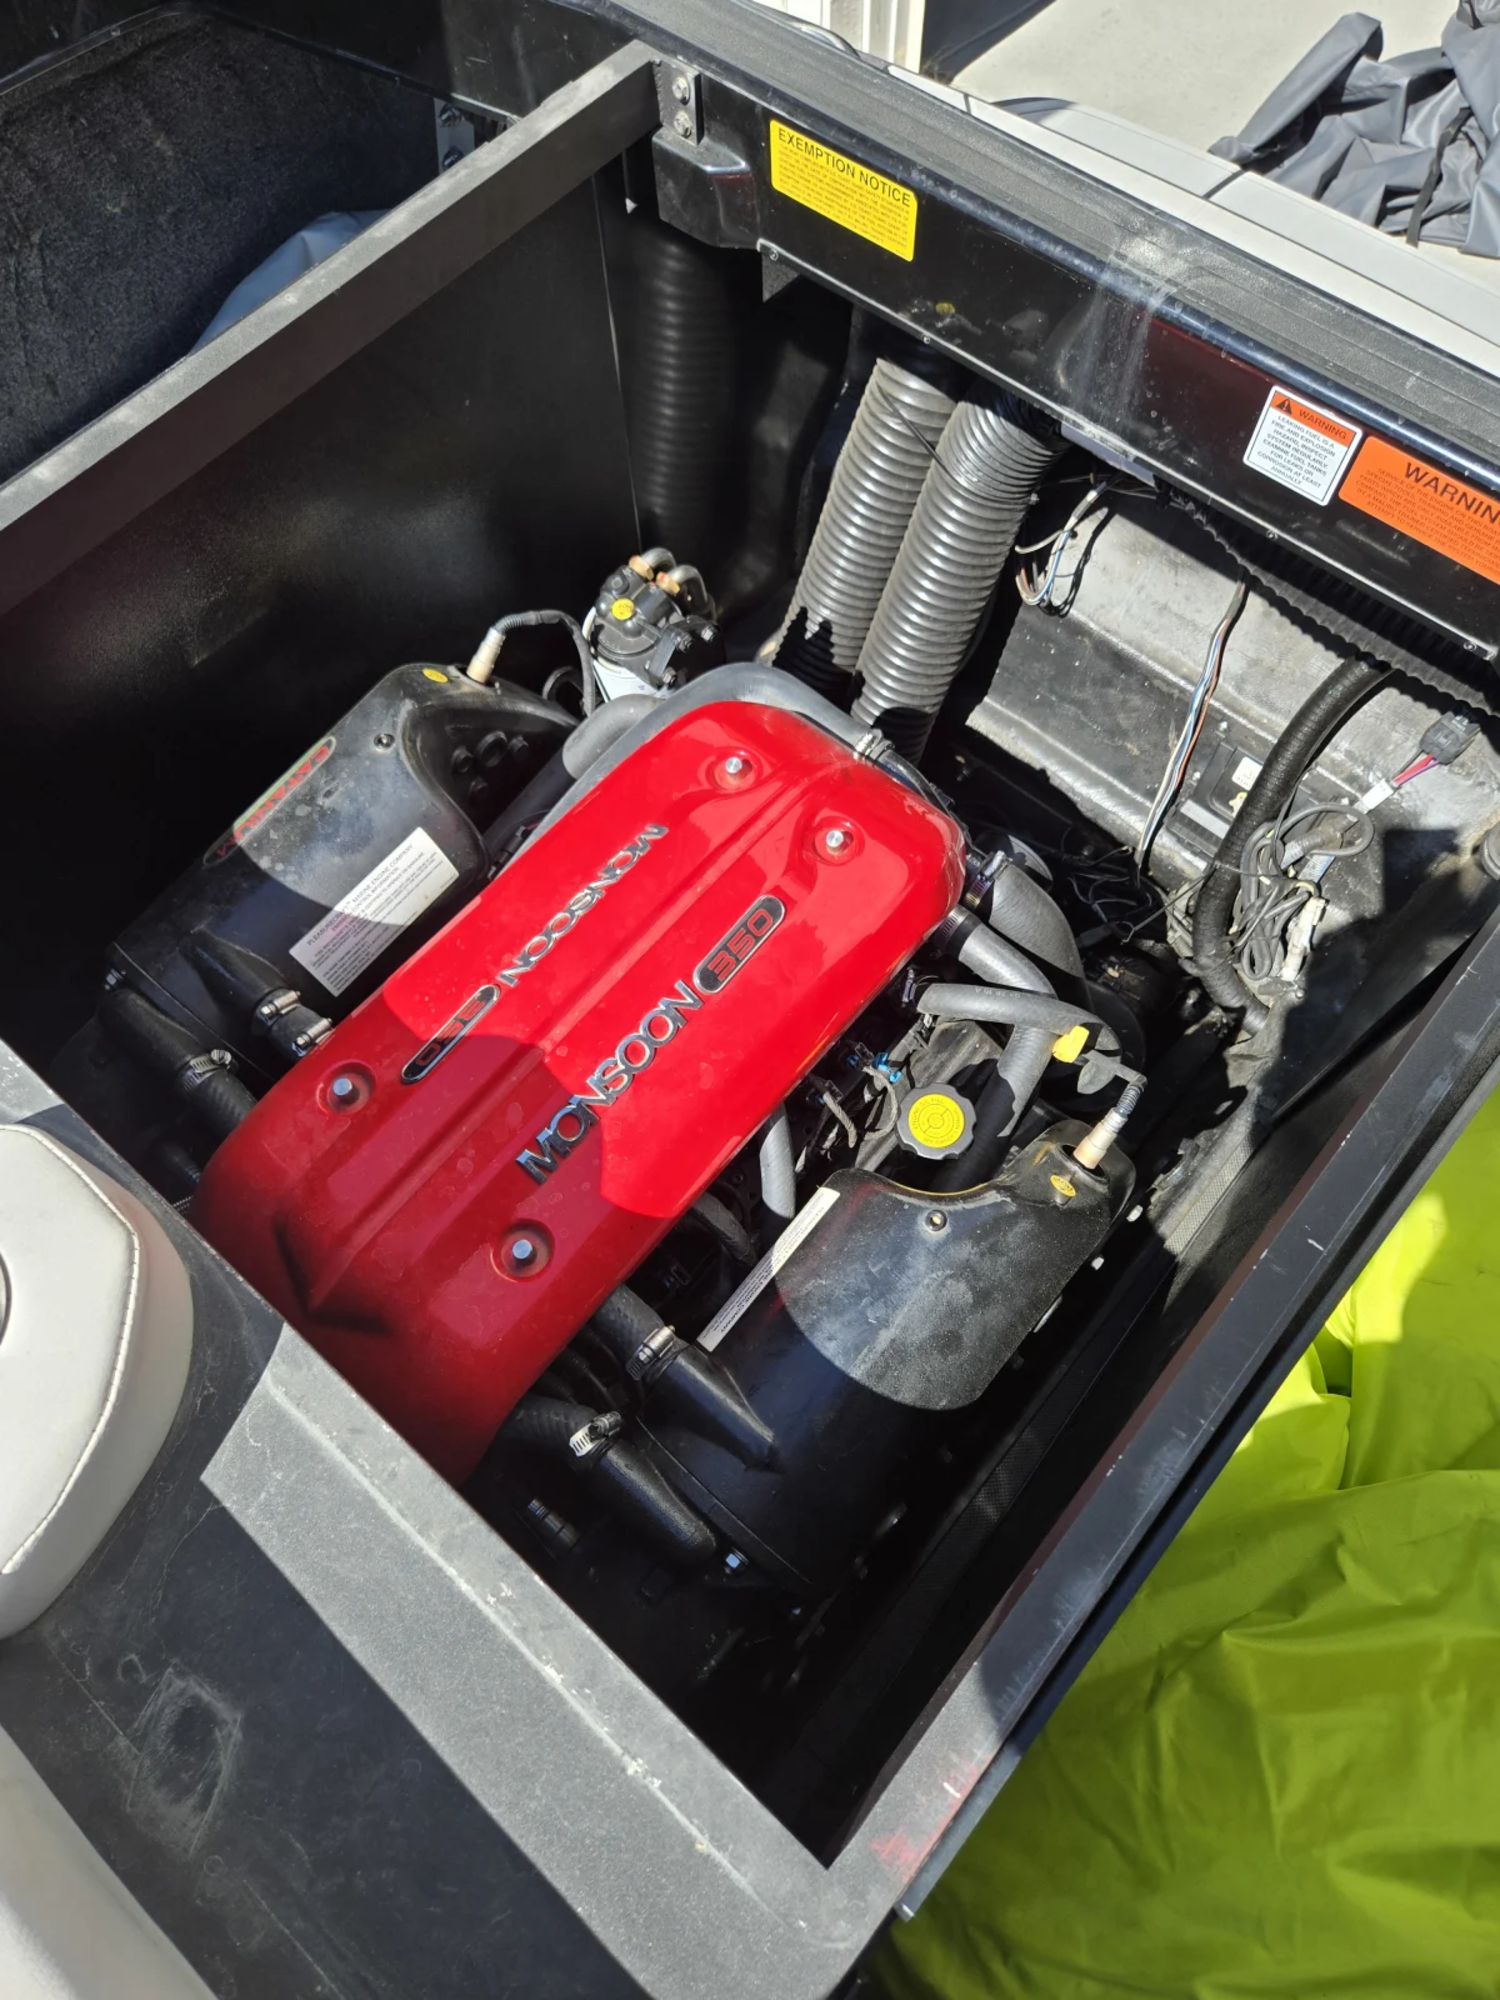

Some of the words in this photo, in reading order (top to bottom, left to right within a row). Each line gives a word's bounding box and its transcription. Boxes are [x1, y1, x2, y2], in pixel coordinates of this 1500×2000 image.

[779, 128, 855, 178] EXEMPTION
[860, 171, 910, 207] NOTICE
[1266, 433, 1291, 448] SYSTEM
[1271, 420, 1284, 429] FIRE
[1285, 428, 1299, 437] AND
[1299, 435, 1335, 456] EXPLOSION
[1277, 416, 1304, 432] LEAKING
[1305, 430, 1321, 441] FUEL
[1299, 410, 1347, 438] WARNING
[1257, 451, 1293, 472] CORROSION
[1302, 475, 1320, 487] LEAST
[1263, 439, 1289, 455] EXAMINE
[1290, 454, 1305, 464] FUEL
[1306, 463, 1326, 475] TANKS
[1270, 450, 1282, 459] FOR
[1283, 457, 1303, 470] LEAKS
[1300, 444, 1327, 459] INSPECT
[1405, 463, 1500, 525] WARNIN
[351, 884, 371, 902] MARINE
[370, 866, 390, 884] ENGINE
[388, 844, 414, 867] COMPANY
[497, 824, 669, 987] MONSOON
[416, 998, 486, 1066] 350
[515, 980, 705, 1185] MONSOON
[708, 908, 774, 981] 350
